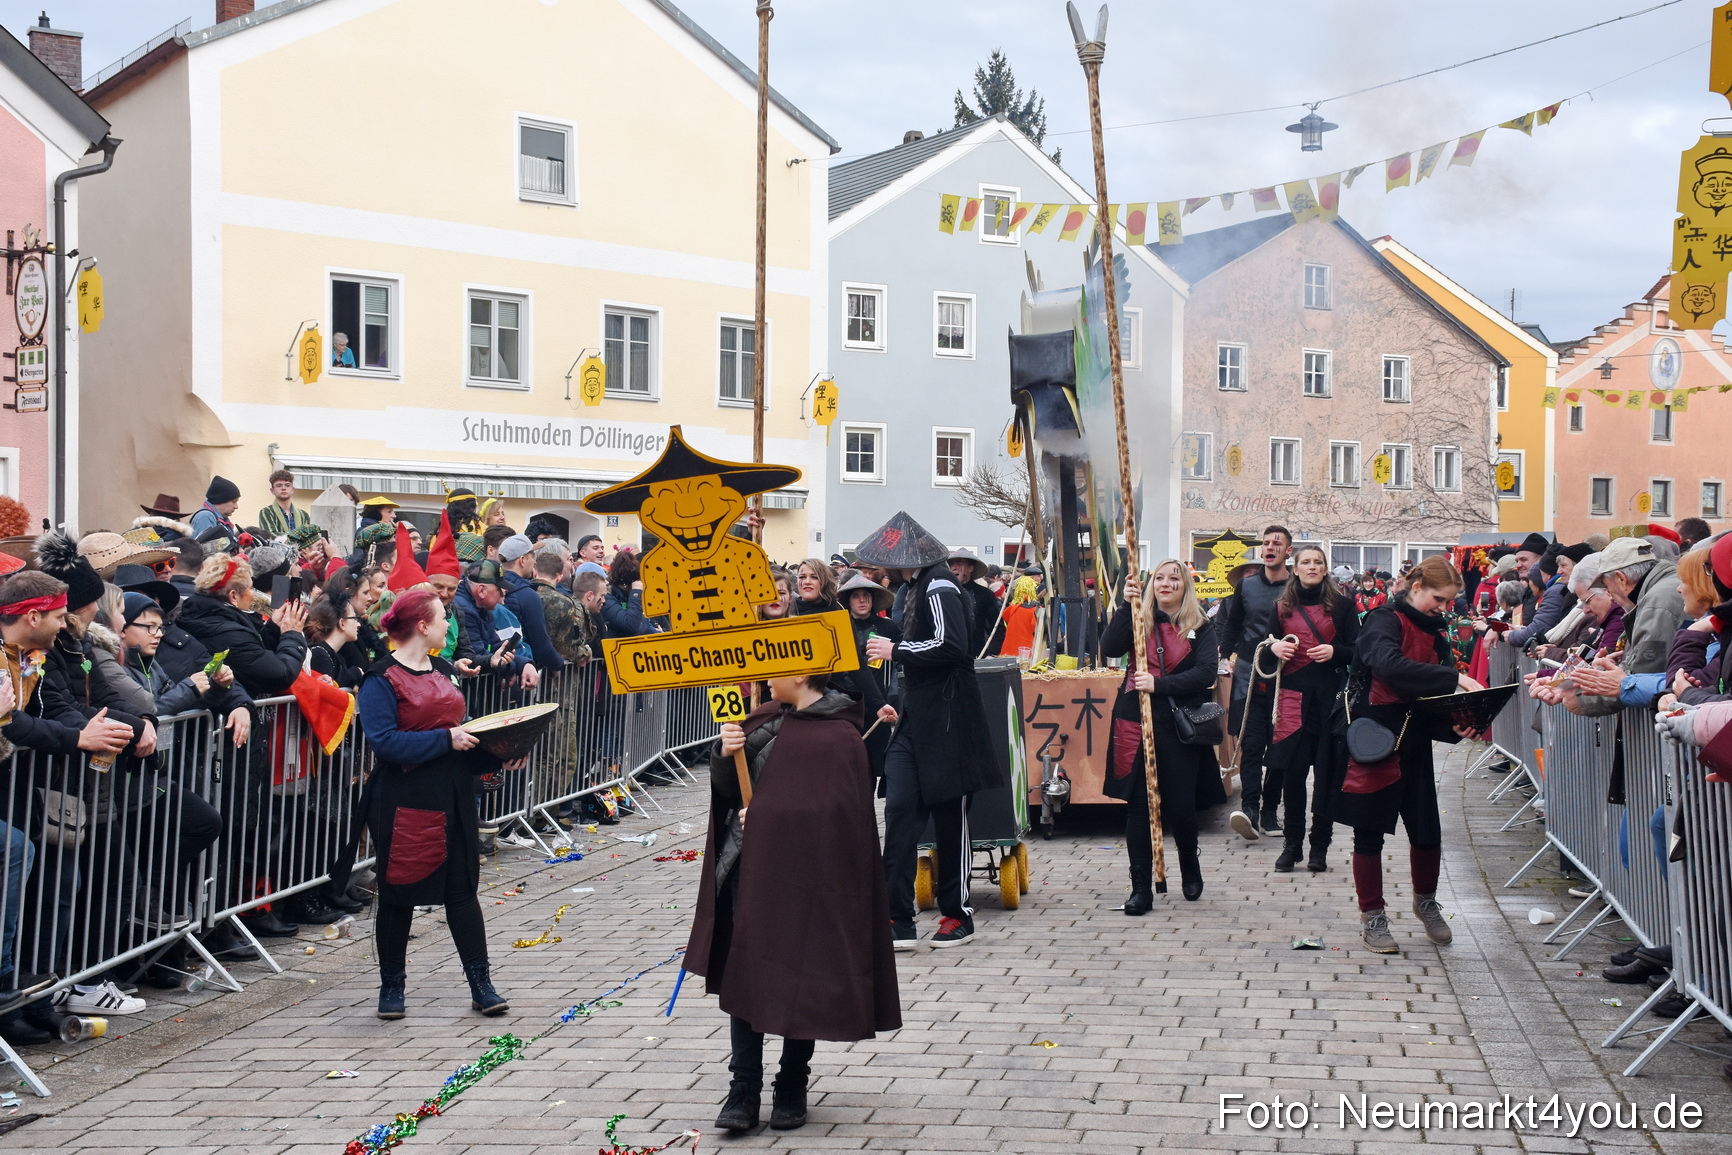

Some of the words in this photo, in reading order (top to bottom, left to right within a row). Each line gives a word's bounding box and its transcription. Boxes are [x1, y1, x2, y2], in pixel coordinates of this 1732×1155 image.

[462, 416, 571, 446] Schuhmoden
[579, 425, 665, 455] Döllinger
[632, 638, 814, 675] Ching-Chang-Chung
[712, 691, 743, 718] 28
